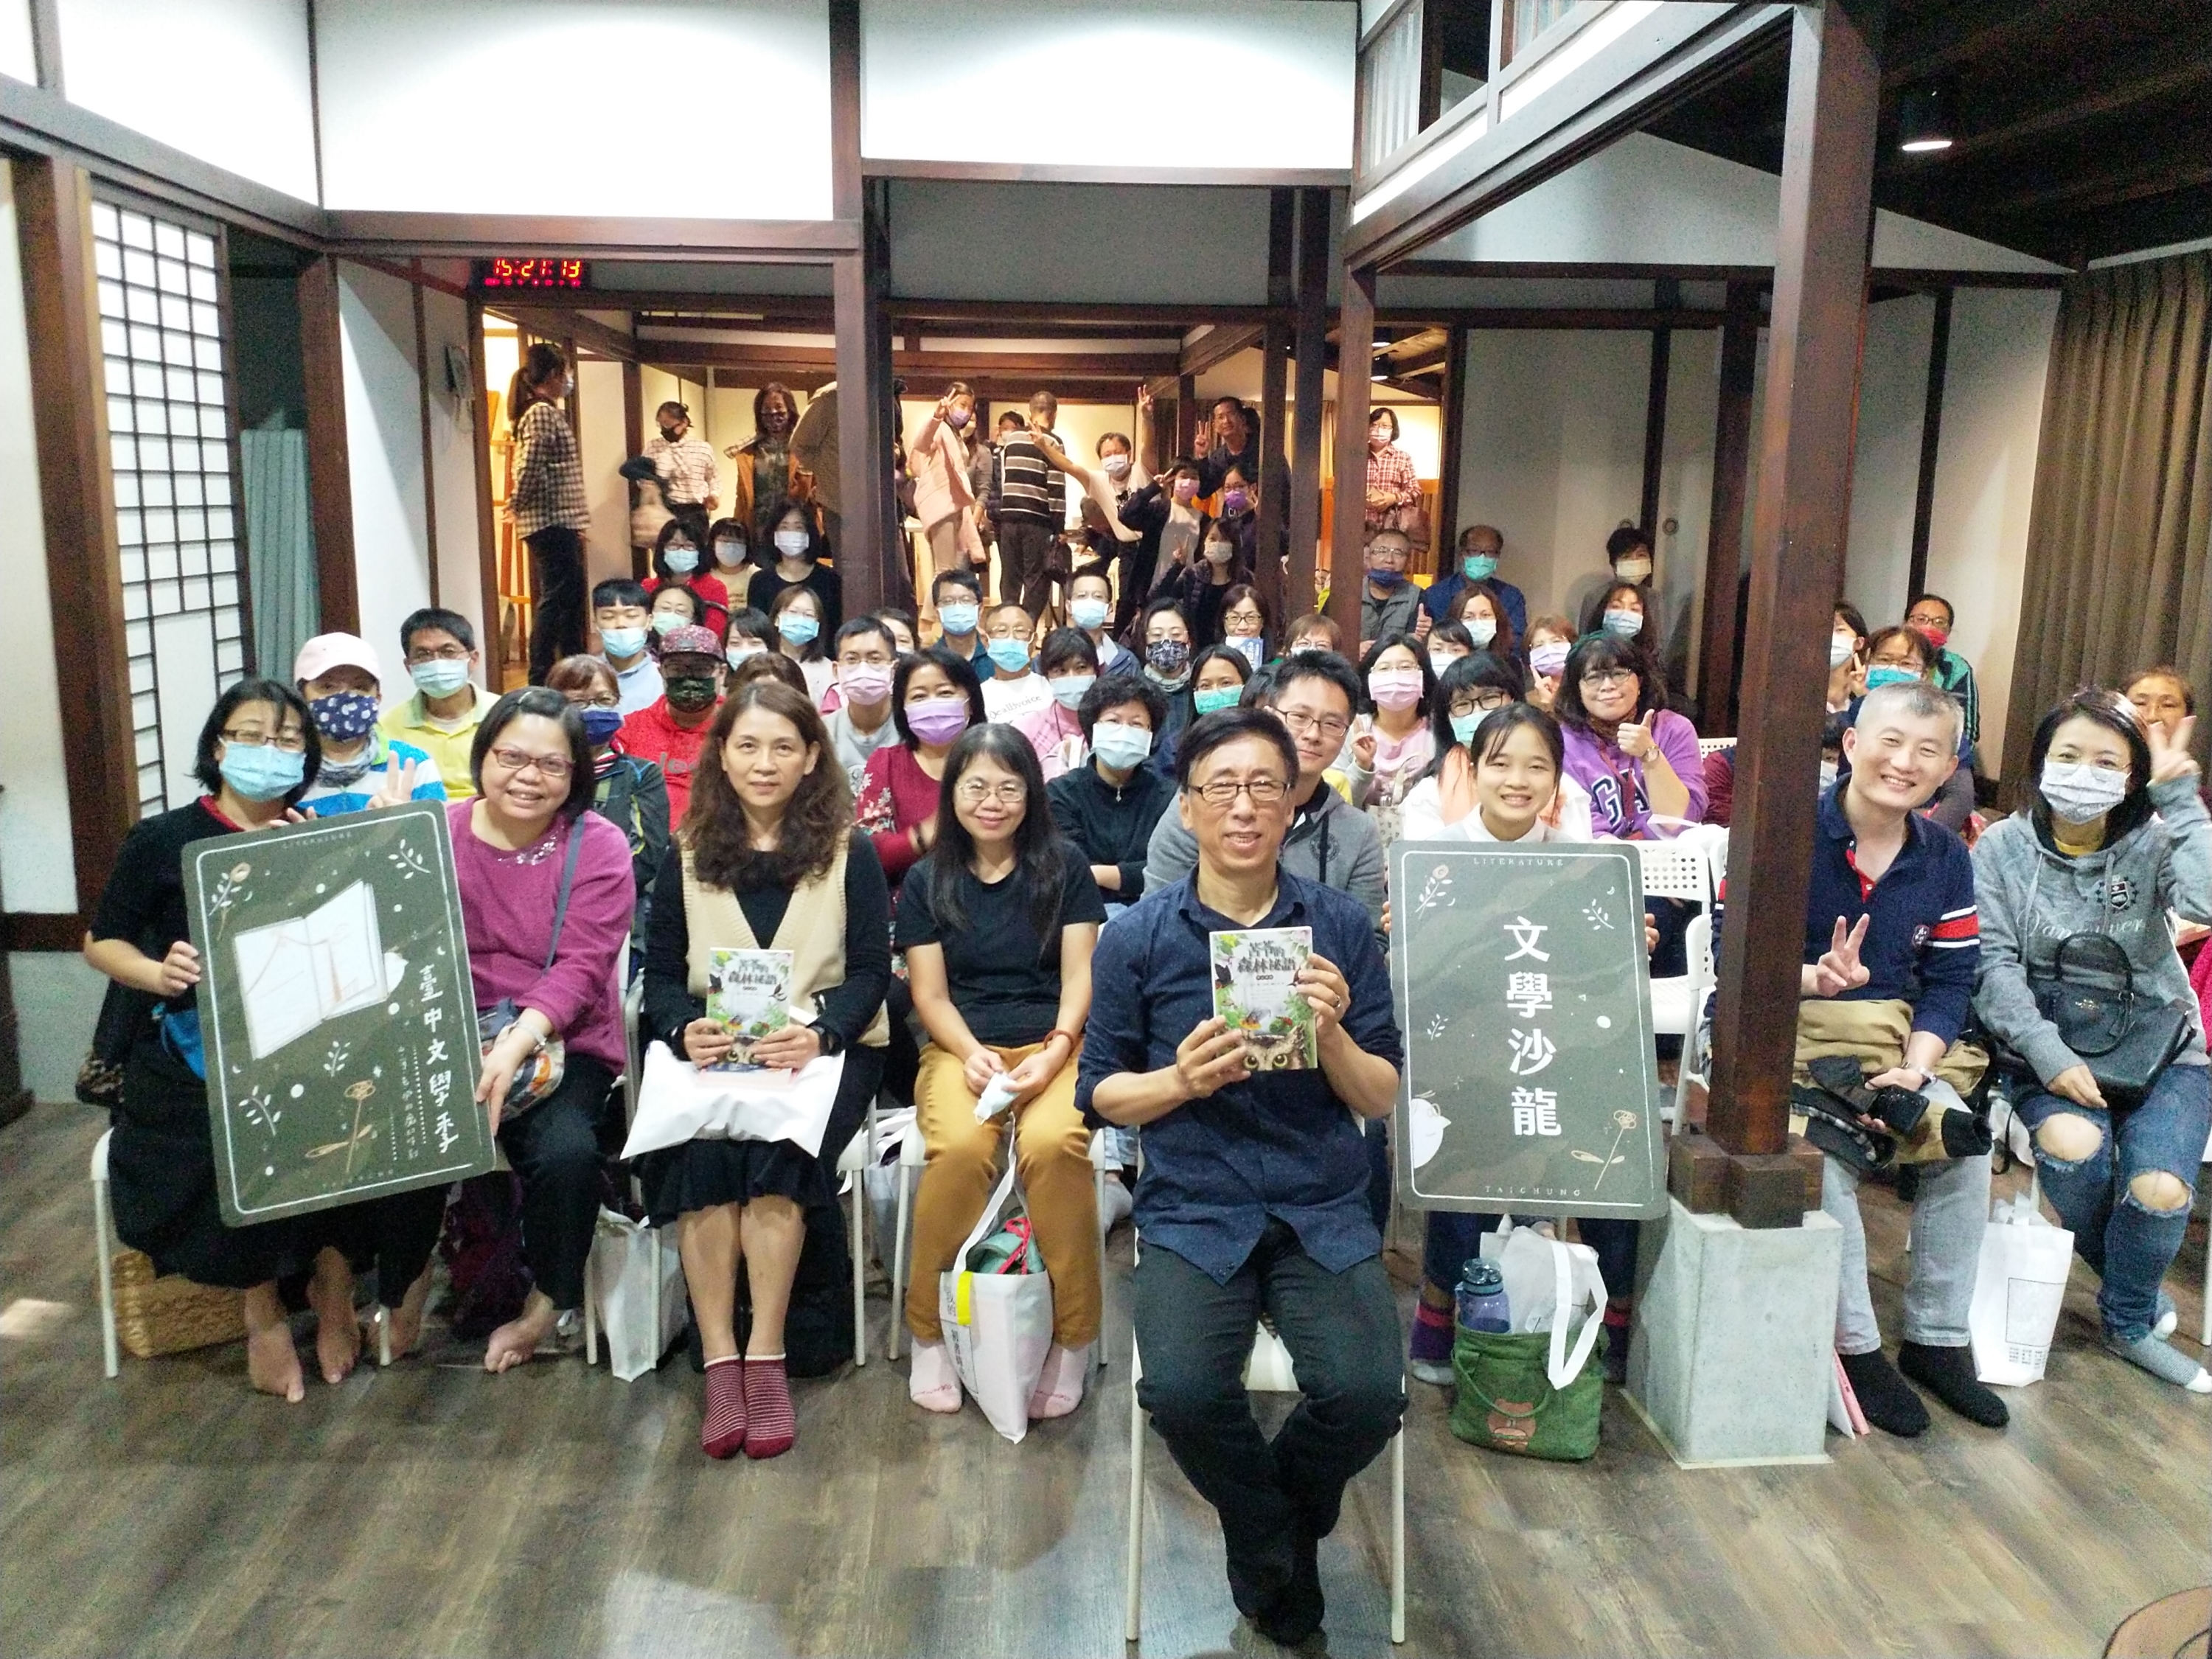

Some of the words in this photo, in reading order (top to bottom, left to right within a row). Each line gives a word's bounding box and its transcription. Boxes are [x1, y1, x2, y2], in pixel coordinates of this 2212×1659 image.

[1591, 768, 1652, 827] GA
[1473, 857, 1564, 866] LITERATURE
[2017, 907, 2146, 940] Vanver
[1503, 915, 1562, 1136] 文學沙龍
[419, 963, 459, 1154] 臺中文學季
[1484, 1185, 1581, 1197] TAICHUNG
